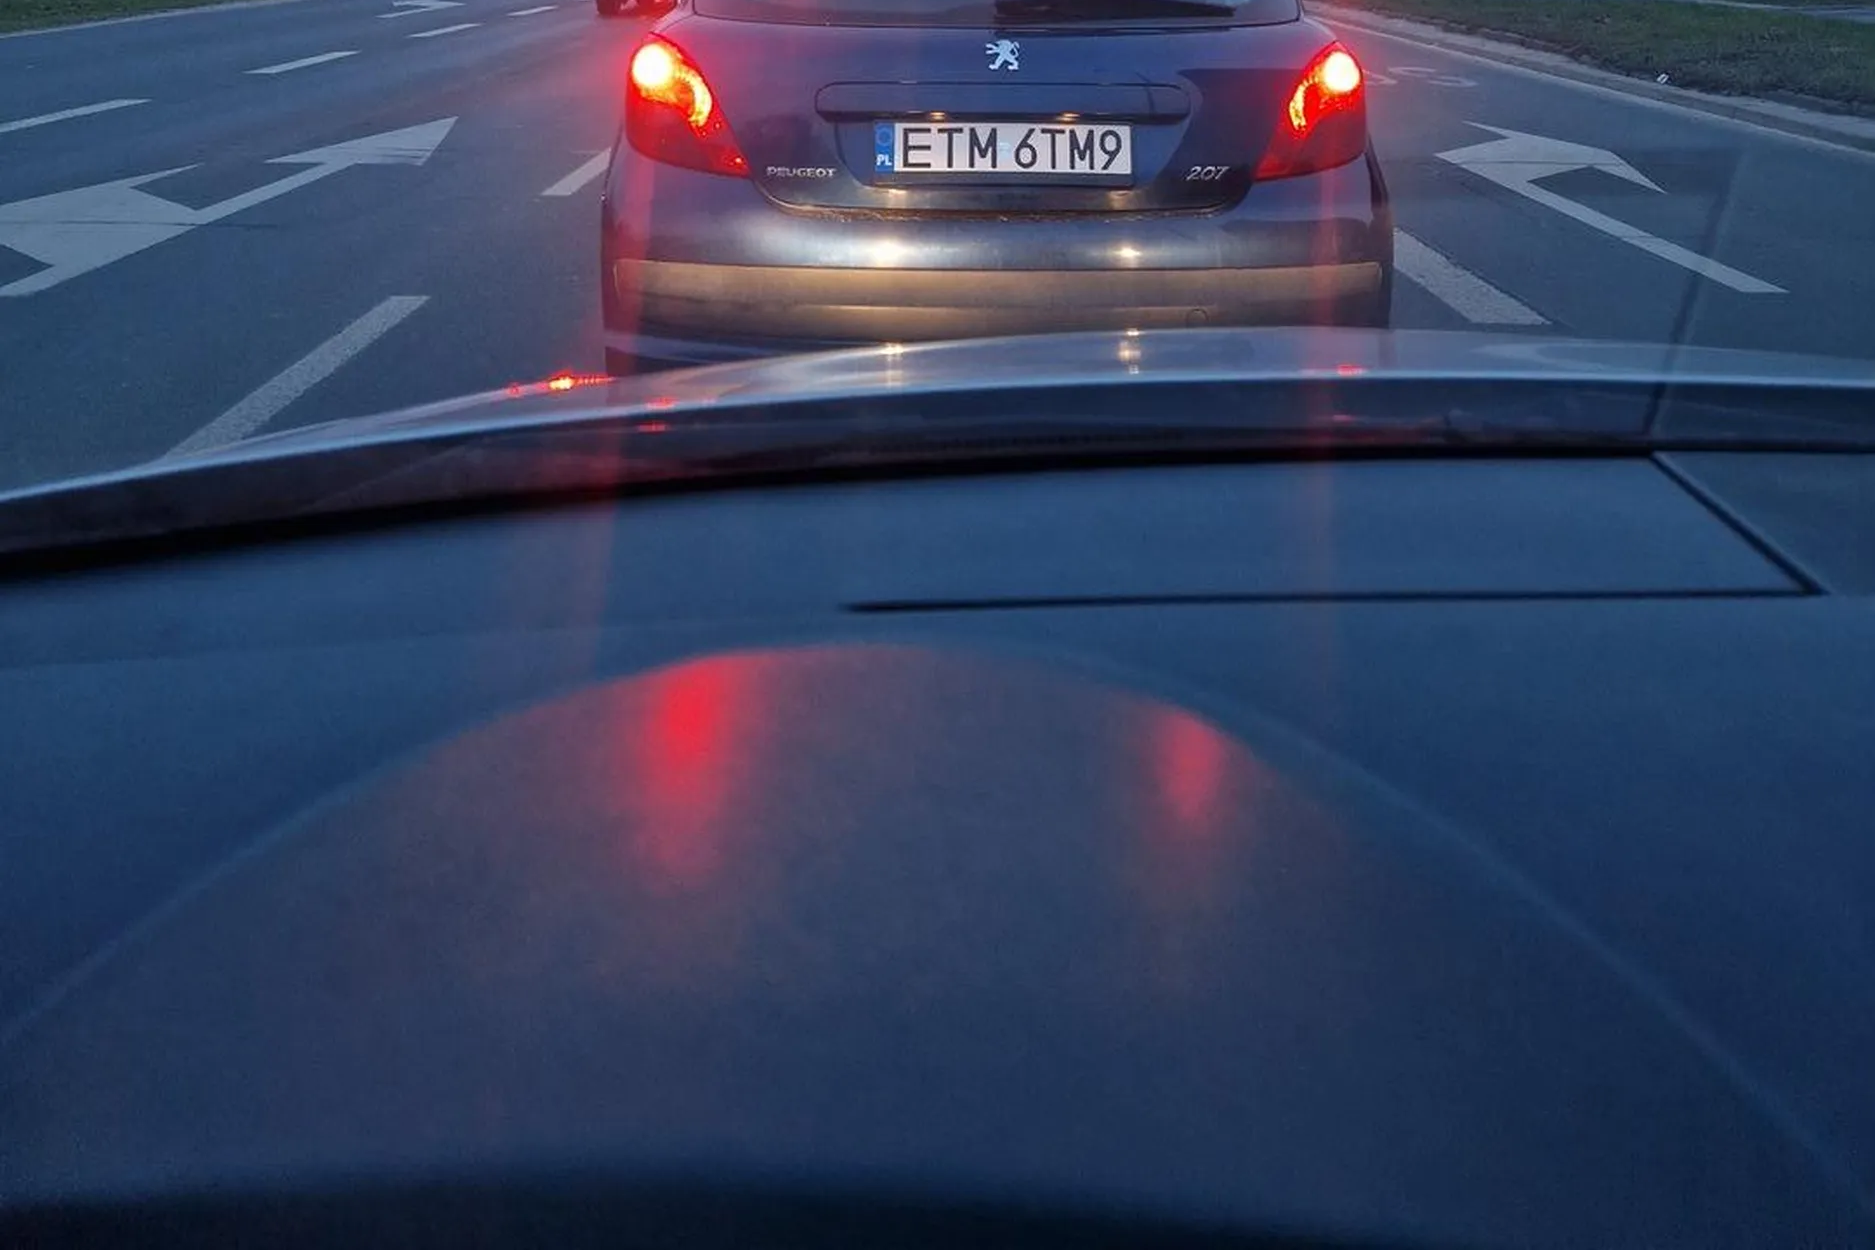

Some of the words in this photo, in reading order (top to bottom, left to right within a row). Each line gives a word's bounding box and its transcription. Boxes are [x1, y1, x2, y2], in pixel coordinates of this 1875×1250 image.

[902, 127, 997, 169] ETM
[1014, 127, 1123, 171] 6TM9
[876, 154, 893, 166] PL
[766, 166, 837, 178] PEUGEOT
[1186, 165, 1230, 181] 207
